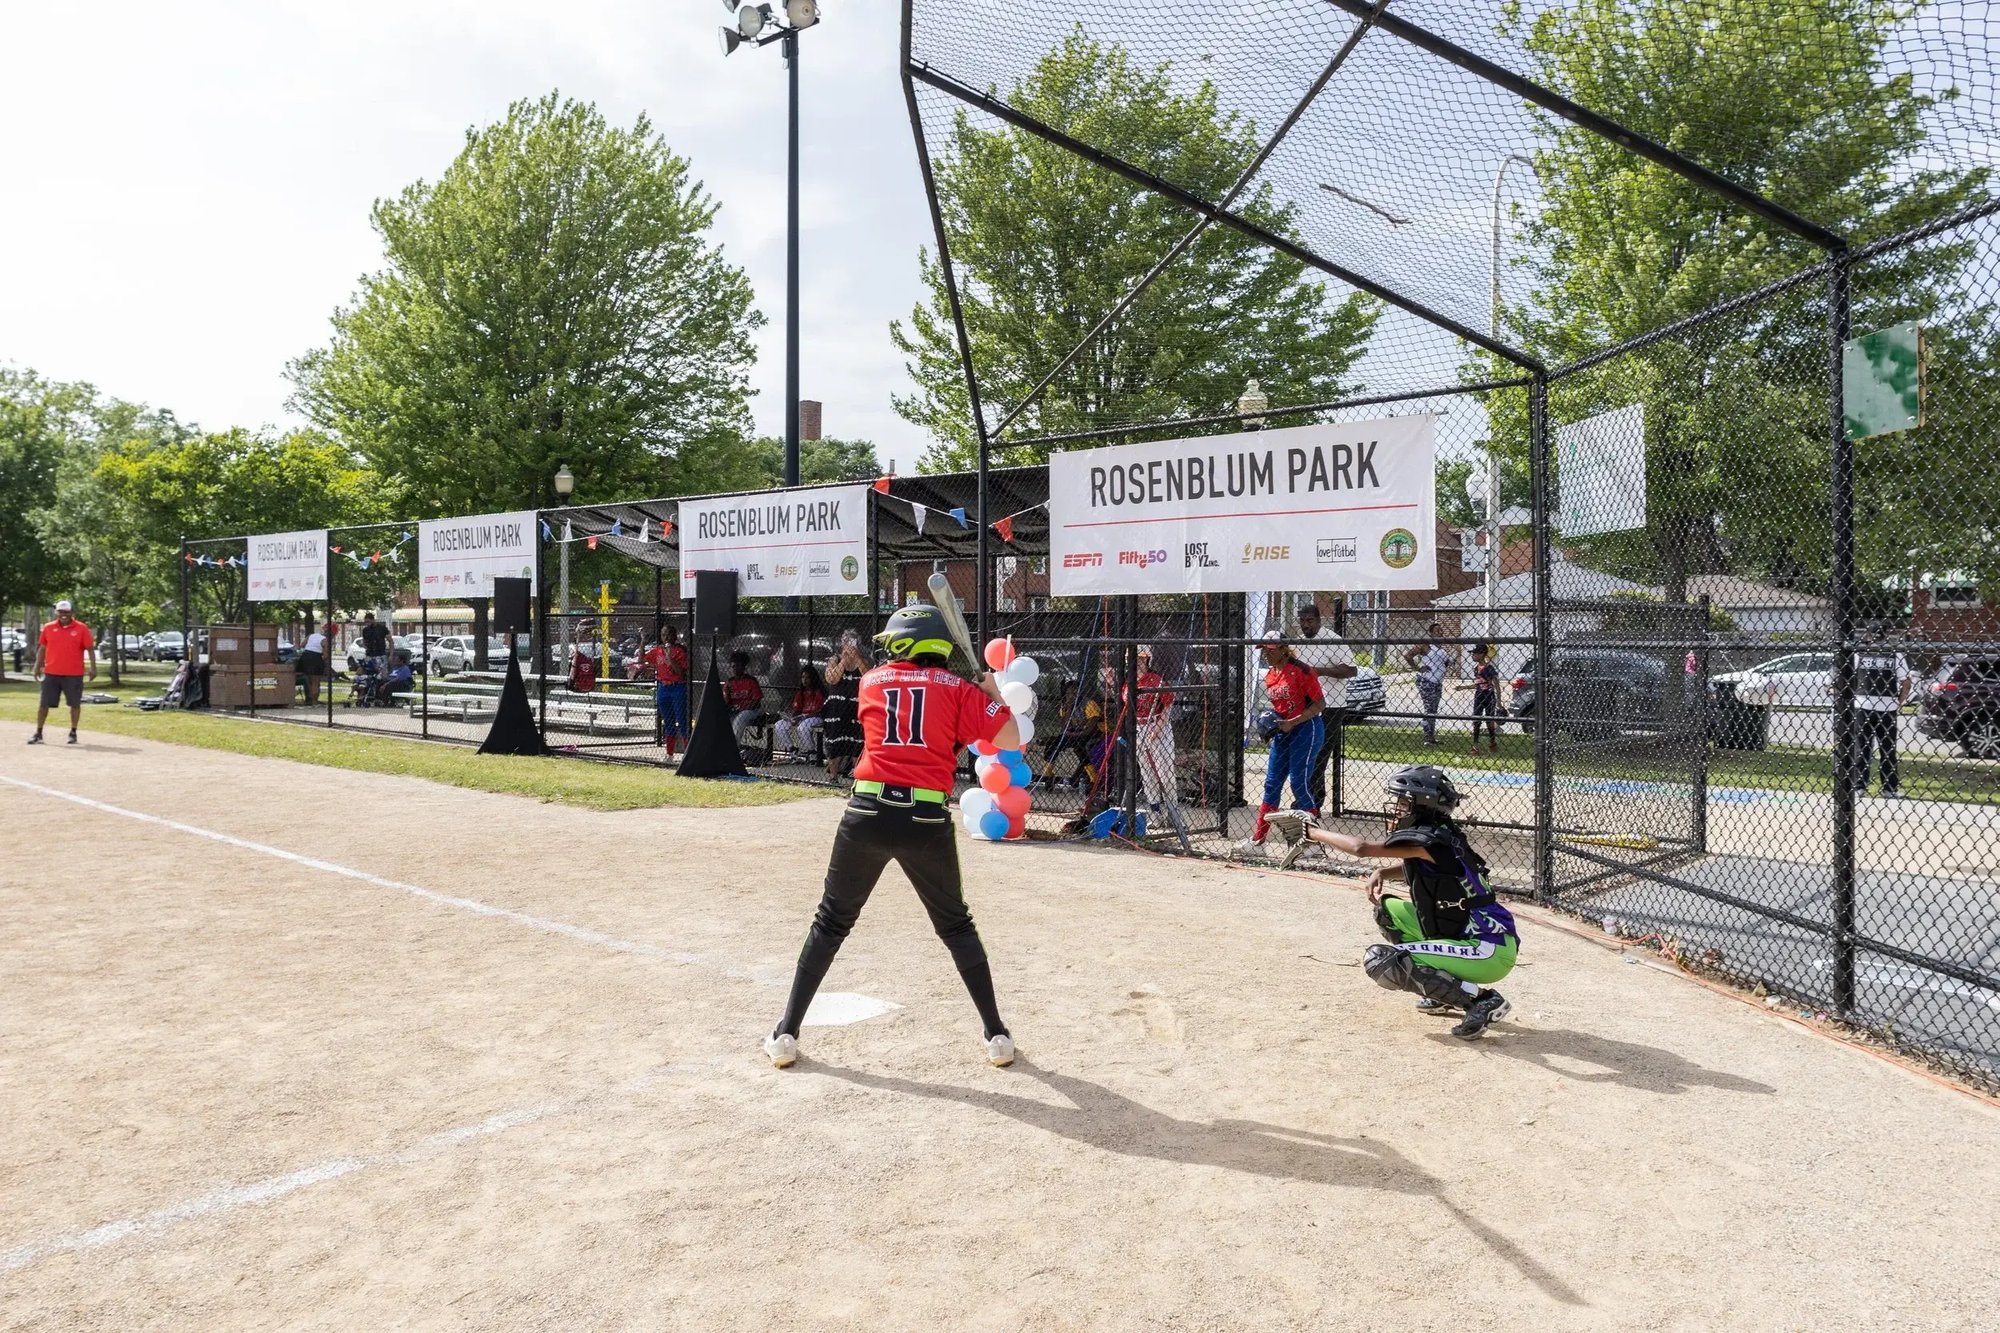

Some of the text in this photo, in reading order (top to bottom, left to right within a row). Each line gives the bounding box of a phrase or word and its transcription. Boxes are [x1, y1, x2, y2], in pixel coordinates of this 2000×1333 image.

[1090, 440, 1381, 508] ROSENBLUM PARK
[698, 500, 842, 539] ROSENBLUM PARK
[433, 523, 522, 552] ROSENBLUM PARK
[257, 539, 319, 562] ROSENBLUM PARK
[1185, 543, 1208, 555] LOST
[1253, 546, 1291, 560] RISE
[1063, 552, 1103, 568] ESPN
[1119, 550, 1168, 569] Fifty50
[779, 565, 798, 576] RISE
[881, 687, 928, 748] 11
[1399, 944, 1481, 957] THUNDE
